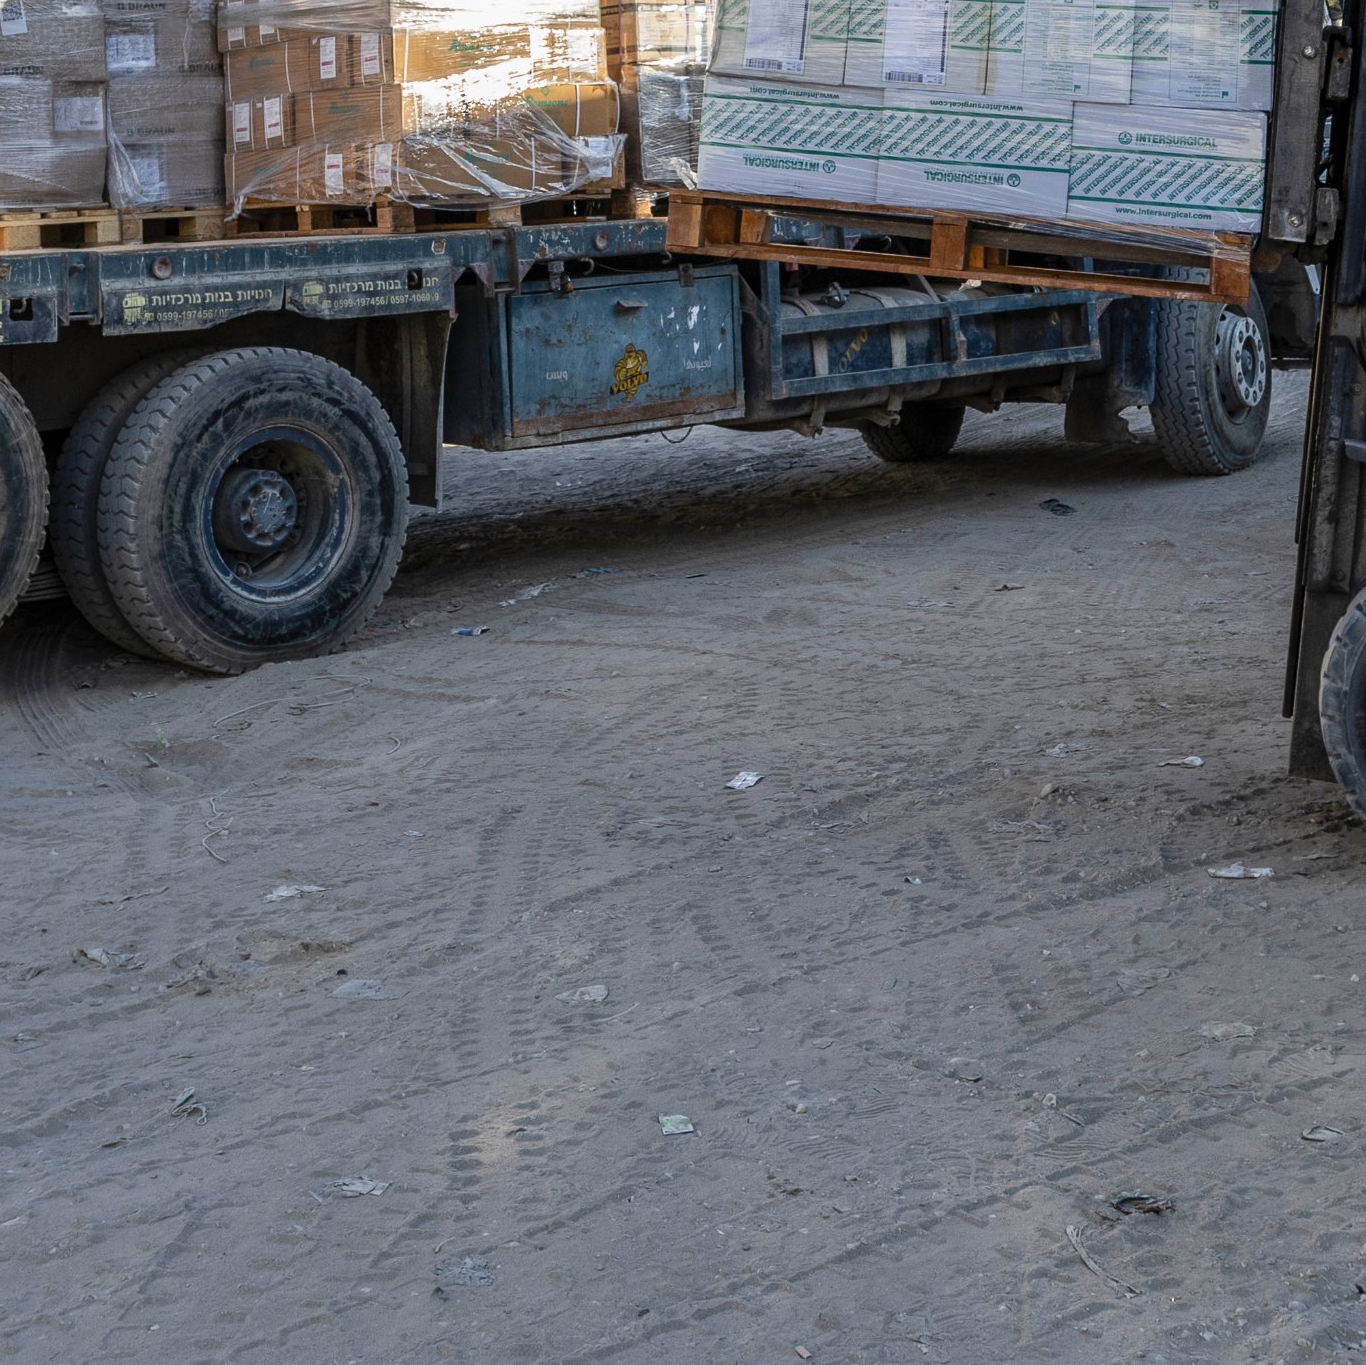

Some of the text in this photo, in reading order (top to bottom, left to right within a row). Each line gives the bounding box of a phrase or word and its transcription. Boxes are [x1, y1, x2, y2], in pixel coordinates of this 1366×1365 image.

[929, 99, 1024, 112] www.intersurgical.com
[1136, 132, 1218, 147] INTERSURGICAL
[743, 155, 819, 172] INTERSURGICAL
[924, 170, 1004, 185] INTERSURGICAL
[1115, 206, 1212, 220] www.intersurgical.com
[329, 281, 374, 294] מרכזיות
[377, 279, 402, 291] בנות
[151, 293, 201, 307] מרכזיות
[611, 372, 649, 394] VOLVO
